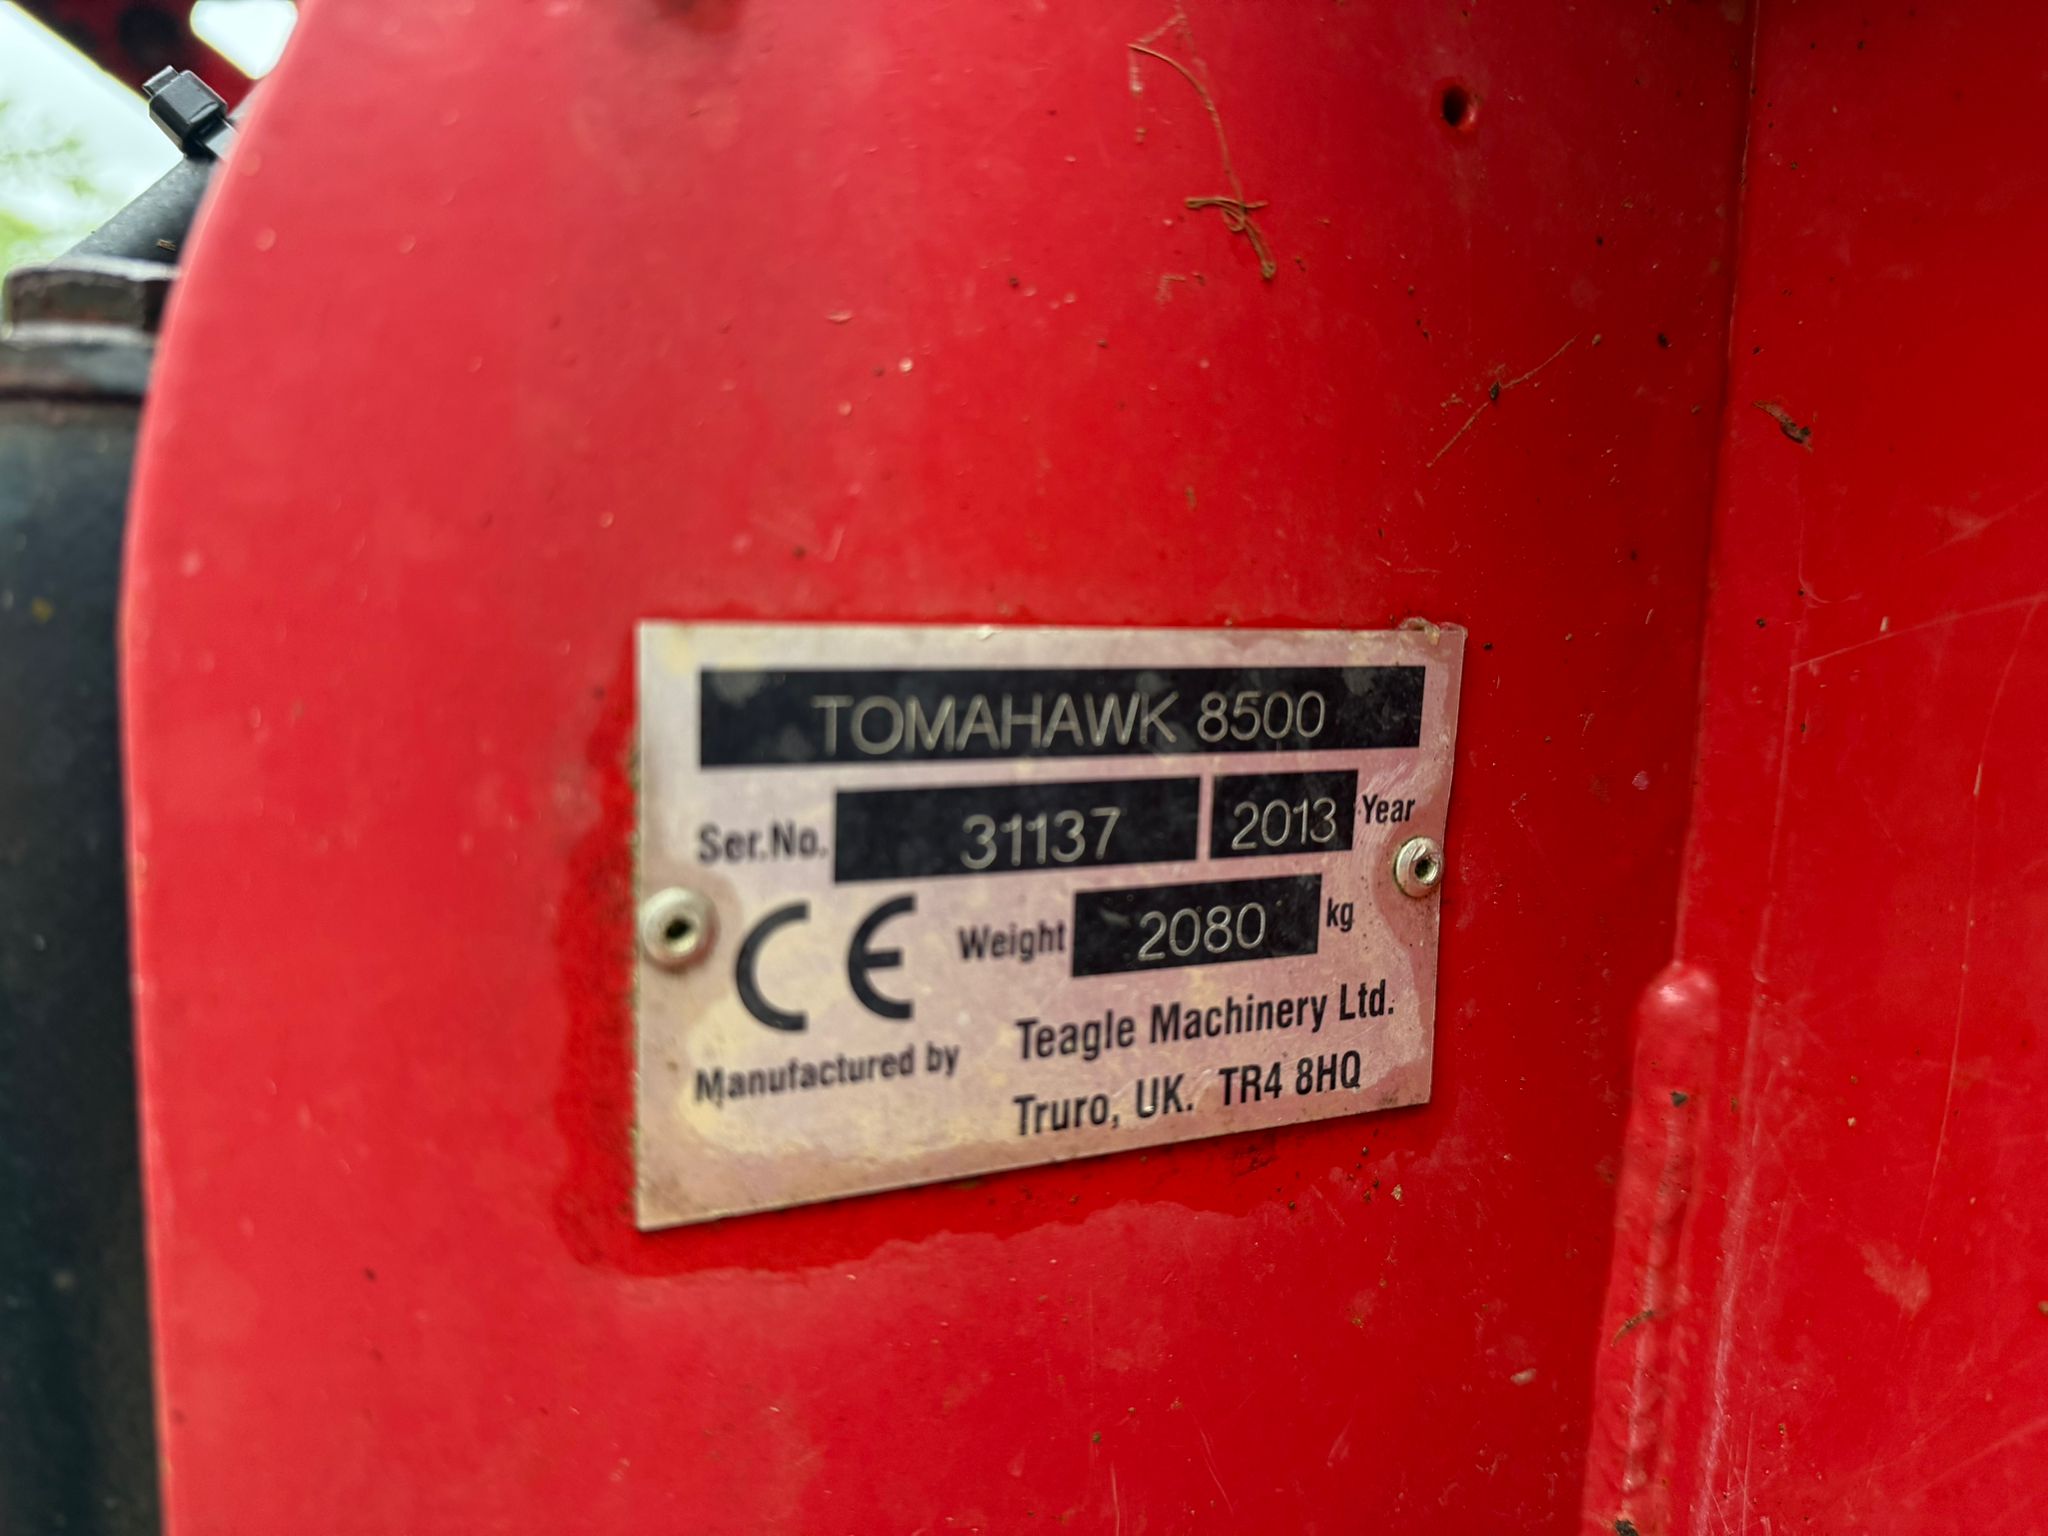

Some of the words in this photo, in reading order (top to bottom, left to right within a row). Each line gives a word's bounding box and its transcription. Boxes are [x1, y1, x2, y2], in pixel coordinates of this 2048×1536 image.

[811, 691, 1178, 756] TOMAHAWK
[1199, 690, 1326, 743] 8500
[697, 823, 827, 864] Ser.No.
[961, 806, 1122, 872] 31137
[1231, 798, 1337, 850] 2013
[1362, 794, 1415, 824] Year
[733, 894, 916, 1032] CE
[957, 921, 1066, 963] Weight
[1137, 901, 1266, 962] 2080
[1326, 898, 1353, 933] kg
[1016, 1010, 1133, 1062] Teagle
[1150, 990, 1328, 1046] Machinery
[1339, 980, 1395, 1019] Ltd.
[694, 1049, 915, 1109] Manufactured
[926, 1038, 959, 1079] by
[1014, 1094, 1121, 1138] Truro,
[1135, 1074, 1193, 1119] UK.
[1219, 1065, 1283, 1107] TR4
[1295, 1050, 1361, 1094] 8HQ
